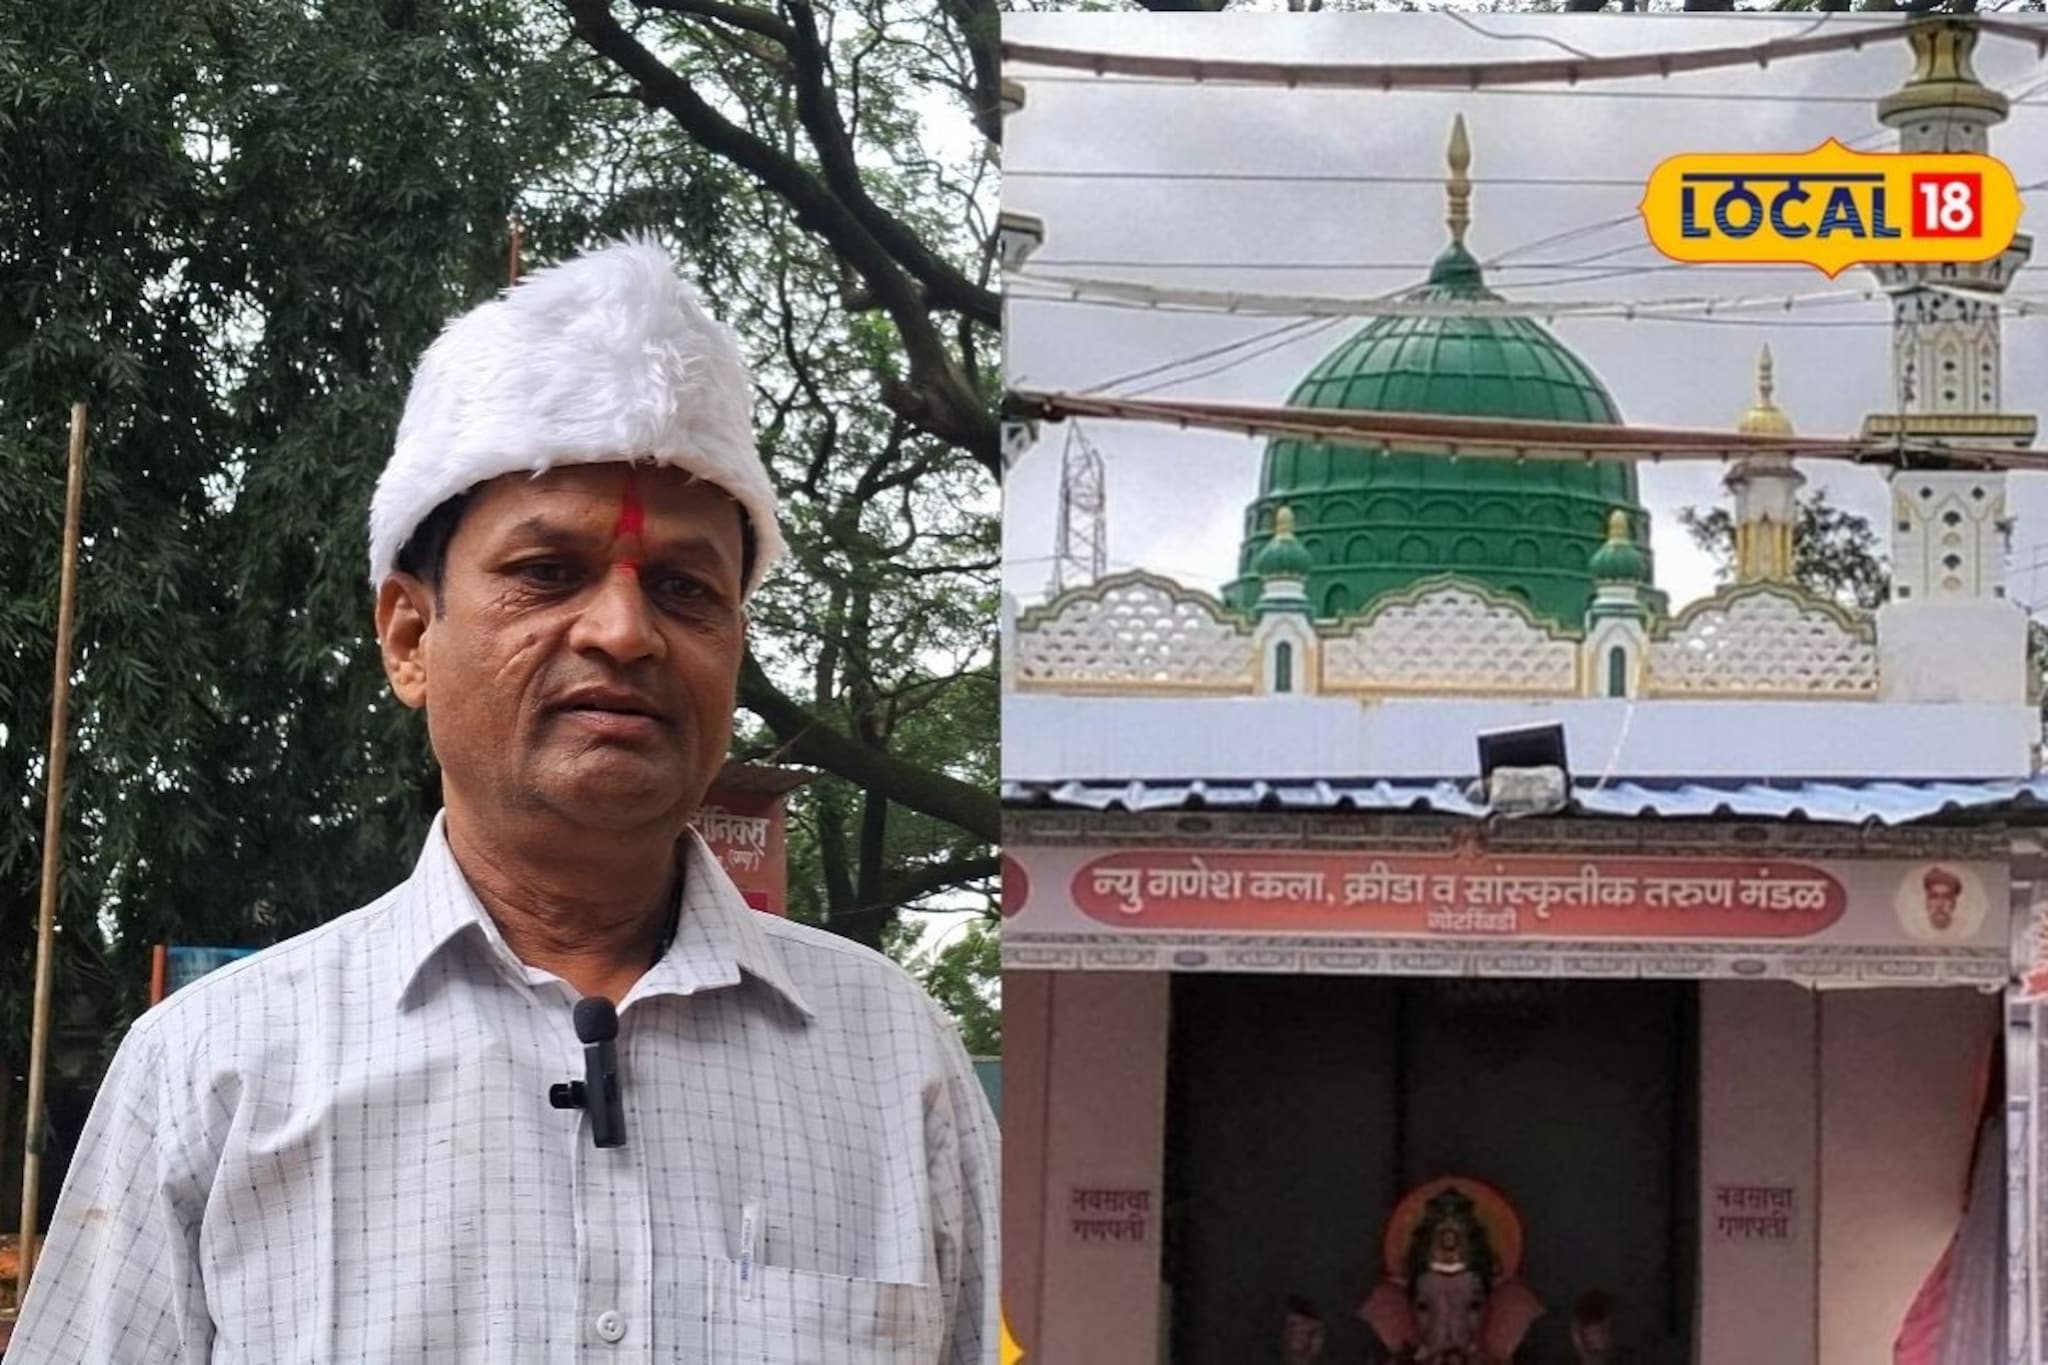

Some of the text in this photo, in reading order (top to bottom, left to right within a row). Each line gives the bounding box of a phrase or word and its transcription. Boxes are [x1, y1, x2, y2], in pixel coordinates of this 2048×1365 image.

[1092, 856, 1829, 919] न्यु गणेश कला, क्रीडा व सांस्कृतीक तरुण मंडळ
